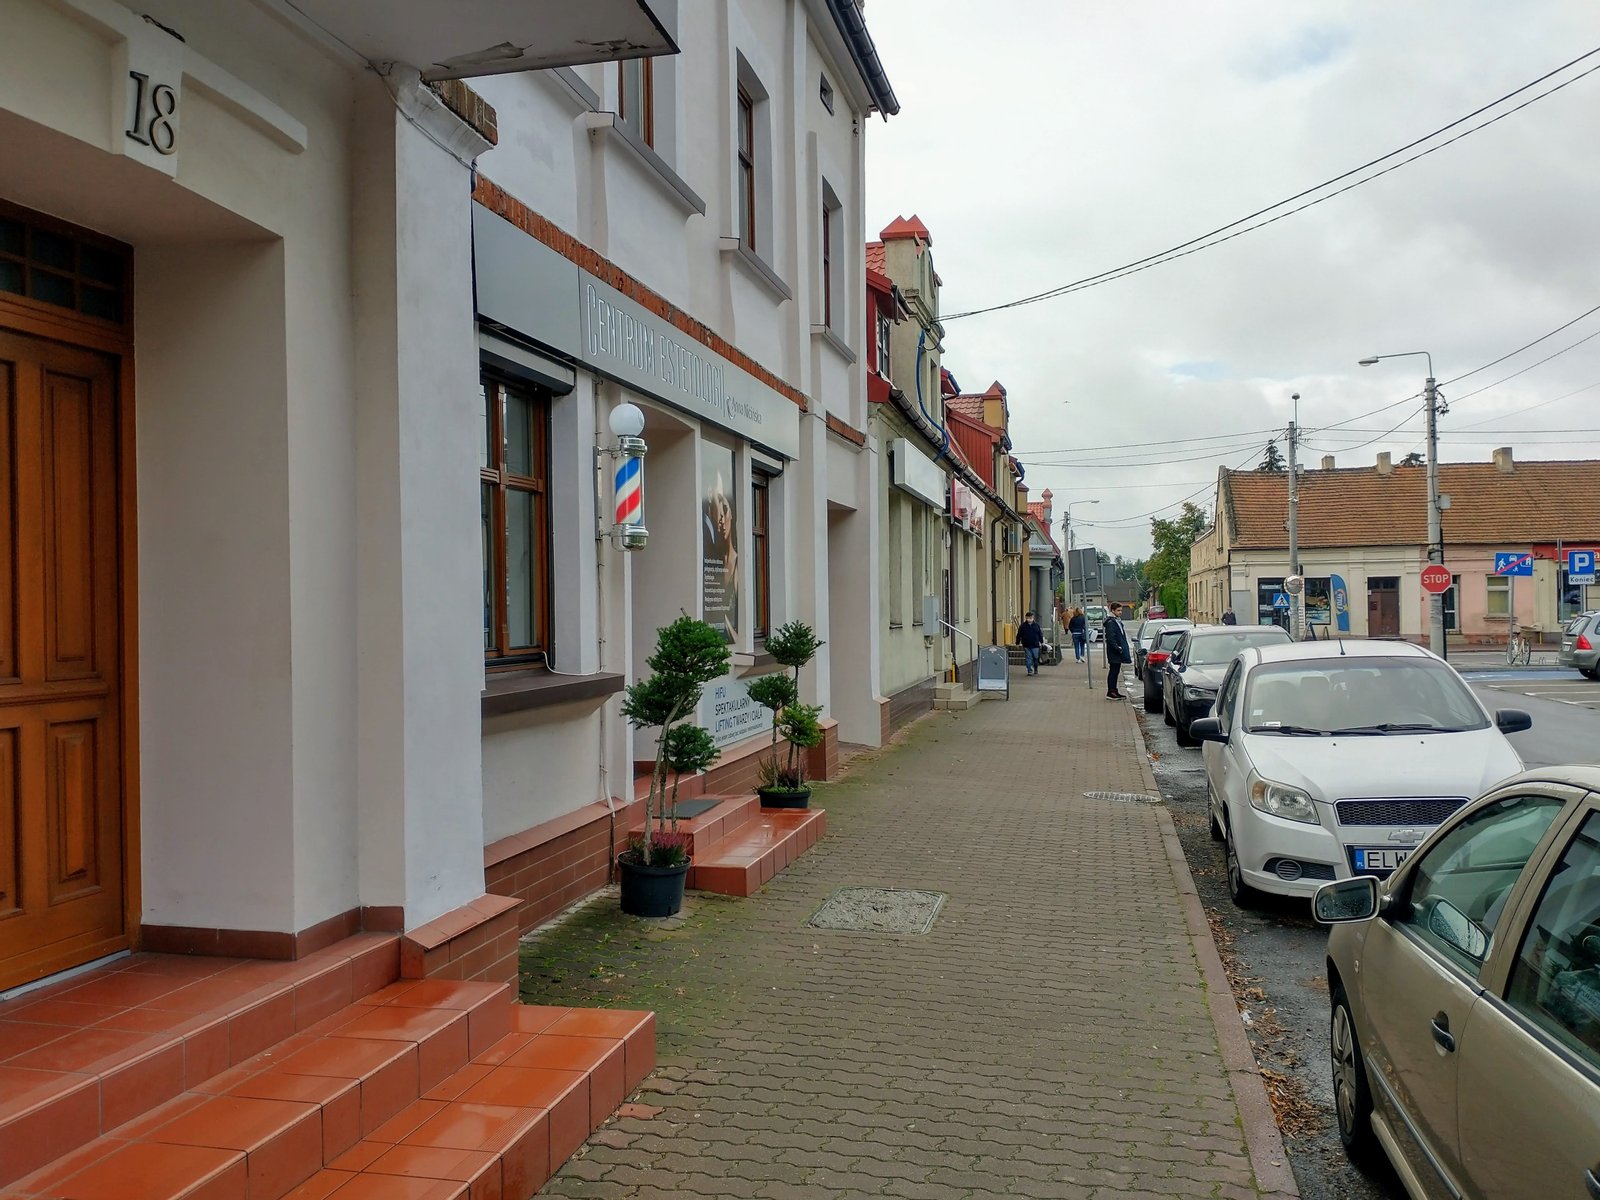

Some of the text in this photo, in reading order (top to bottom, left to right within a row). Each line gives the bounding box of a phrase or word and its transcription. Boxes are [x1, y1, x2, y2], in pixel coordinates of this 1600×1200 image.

[126, 71, 176, 155] 18
[587, 284, 656, 377] CENTRUM
[1574, 553, 1590, 572] P
[1423, 574, 1449, 584] STOP
[715, 686, 727, 699] HIFU
[714, 696, 750, 716] SPEKTAKULARNY
[715, 716, 733, 733] LIFTING
[733, 711, 750, 728] TWARZY
